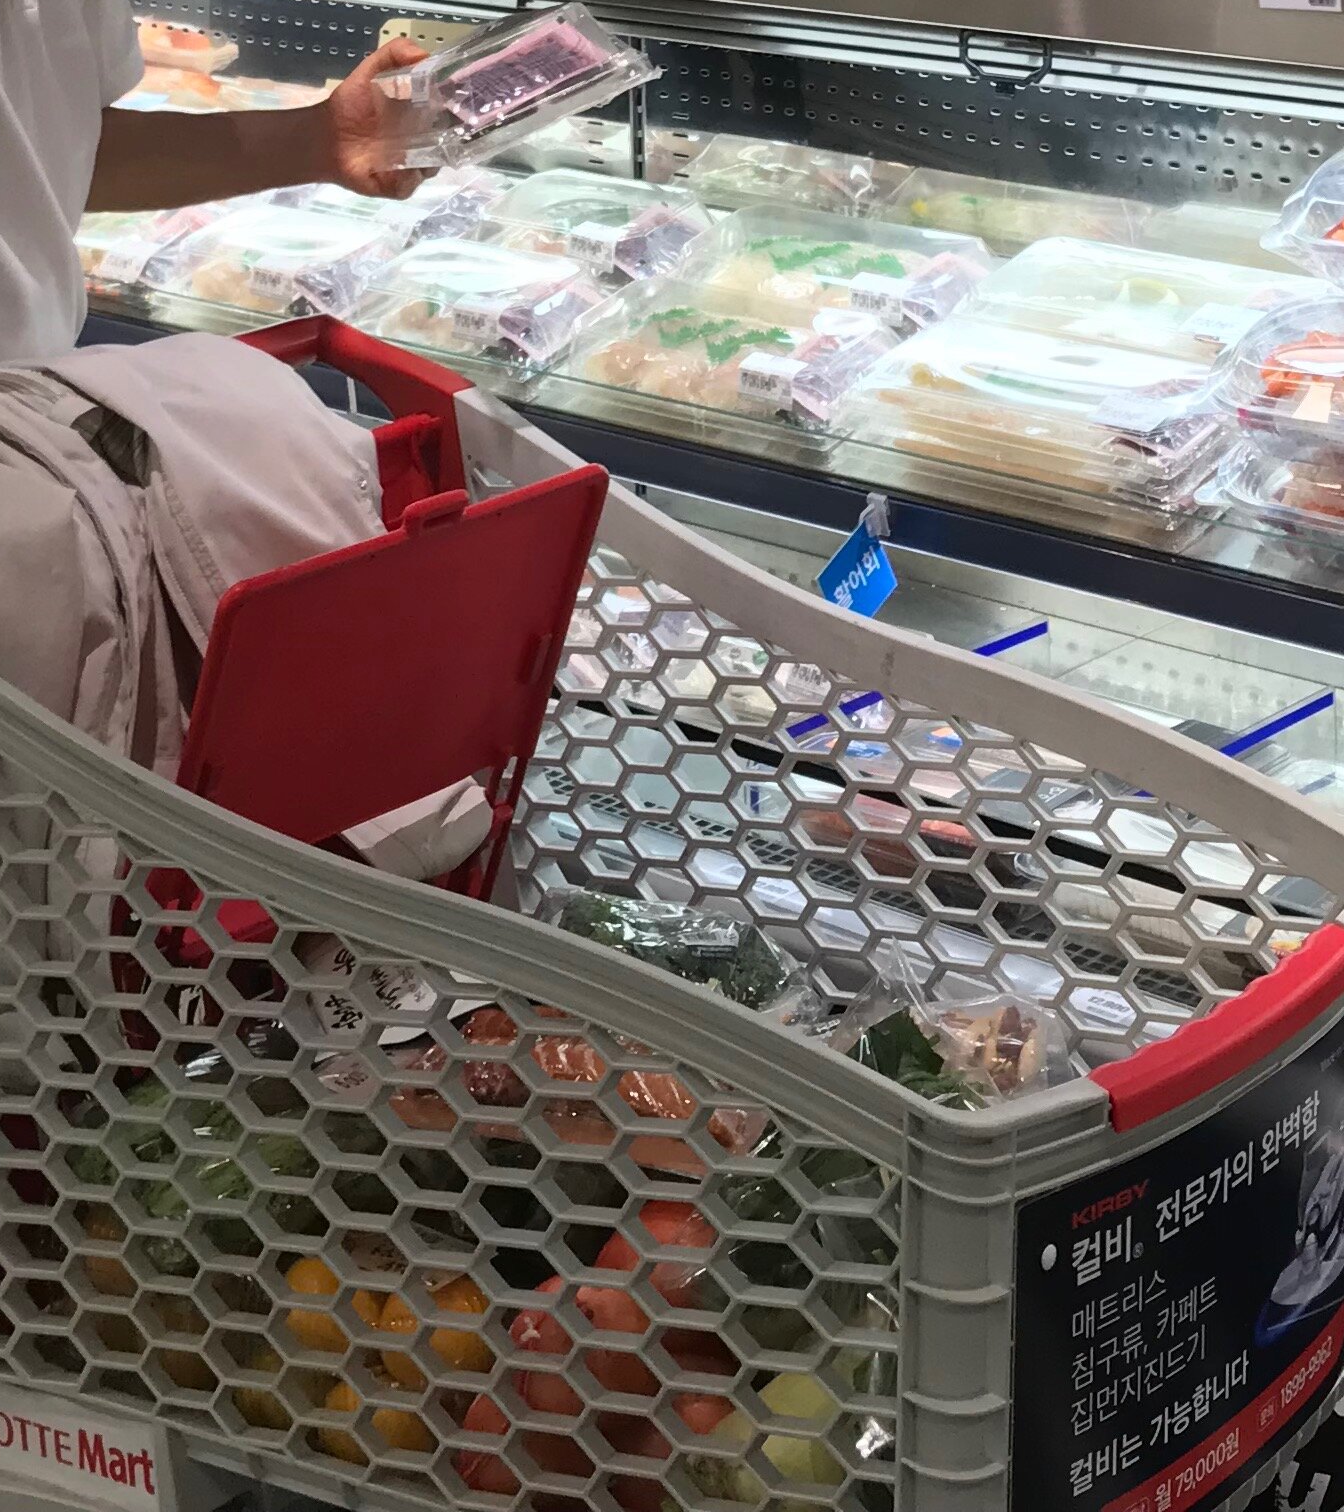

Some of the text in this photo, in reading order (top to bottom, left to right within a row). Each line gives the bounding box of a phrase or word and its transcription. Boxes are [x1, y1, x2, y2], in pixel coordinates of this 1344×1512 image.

[832, 550, 882, 614] 활어회
[1155, 1140, 1256, 1244] 전문가의
[1258, 1089, 1321, 1175] 완벽함
[1071, 1179, 1150, 1229] KIRBY
[1071, 1269, 1167, 1340] 매트리스
[1156, 1276, 1218, 1338] 카페트
[1070, 1324, 1209, 1437] 집먼지진드기
[1069, 1348, 1250, 1498] 컬비는 가능합니다
[77, 1428, 156, 1496] Mart
[1174, 1426, 1241, 1494] 79,000원
